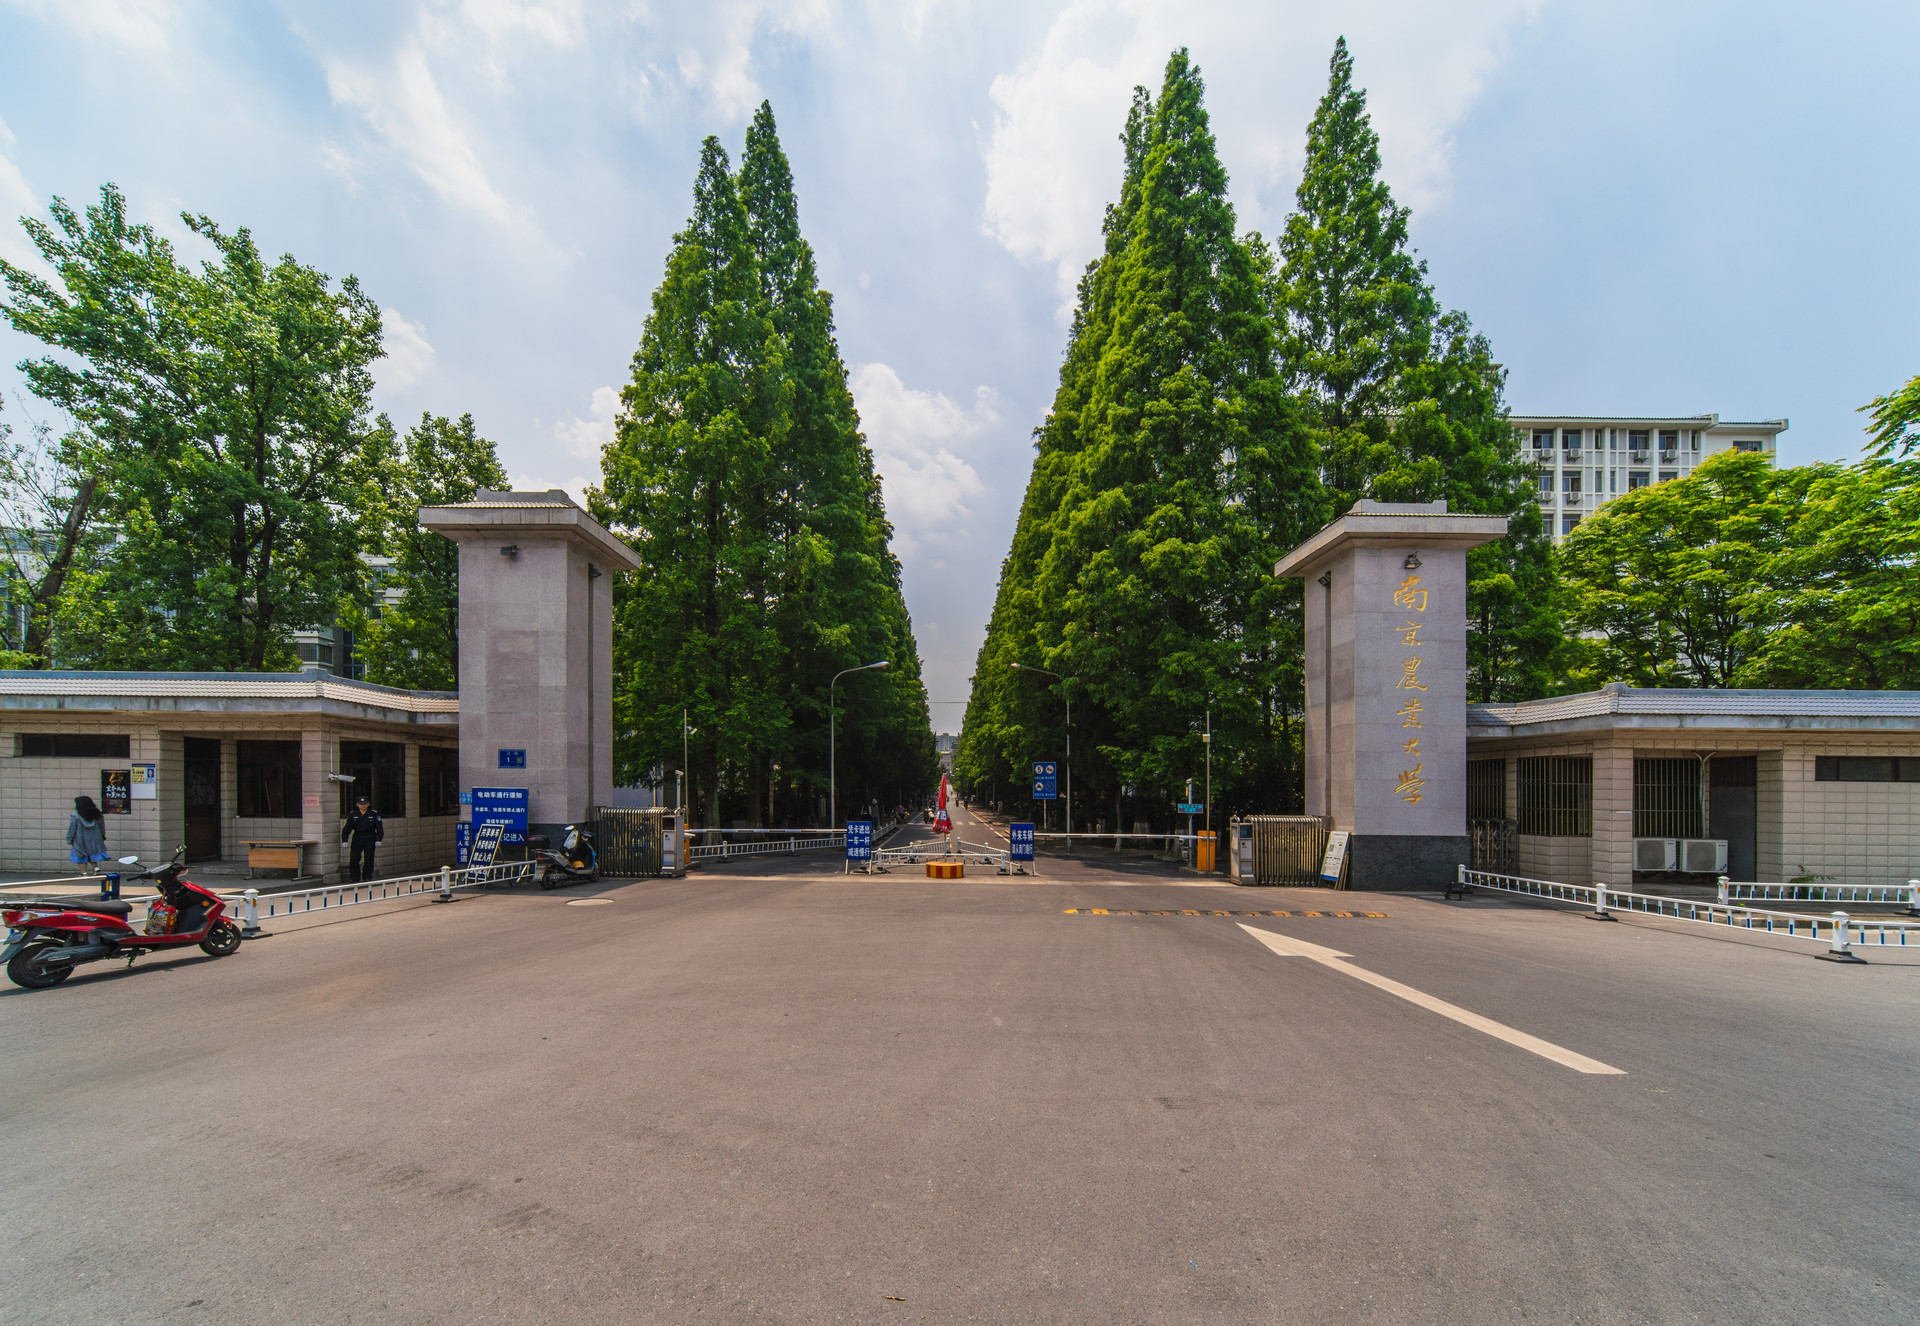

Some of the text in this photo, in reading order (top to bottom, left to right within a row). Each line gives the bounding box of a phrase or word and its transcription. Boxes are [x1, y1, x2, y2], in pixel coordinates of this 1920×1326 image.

[848, 824, 870, 834] 凭卡进出
[1011, 829, 1033, 841] 外来车辆
[848, 836, 870, 845] 一车一杆
[848, 847, 870, 857] 减速慢行
